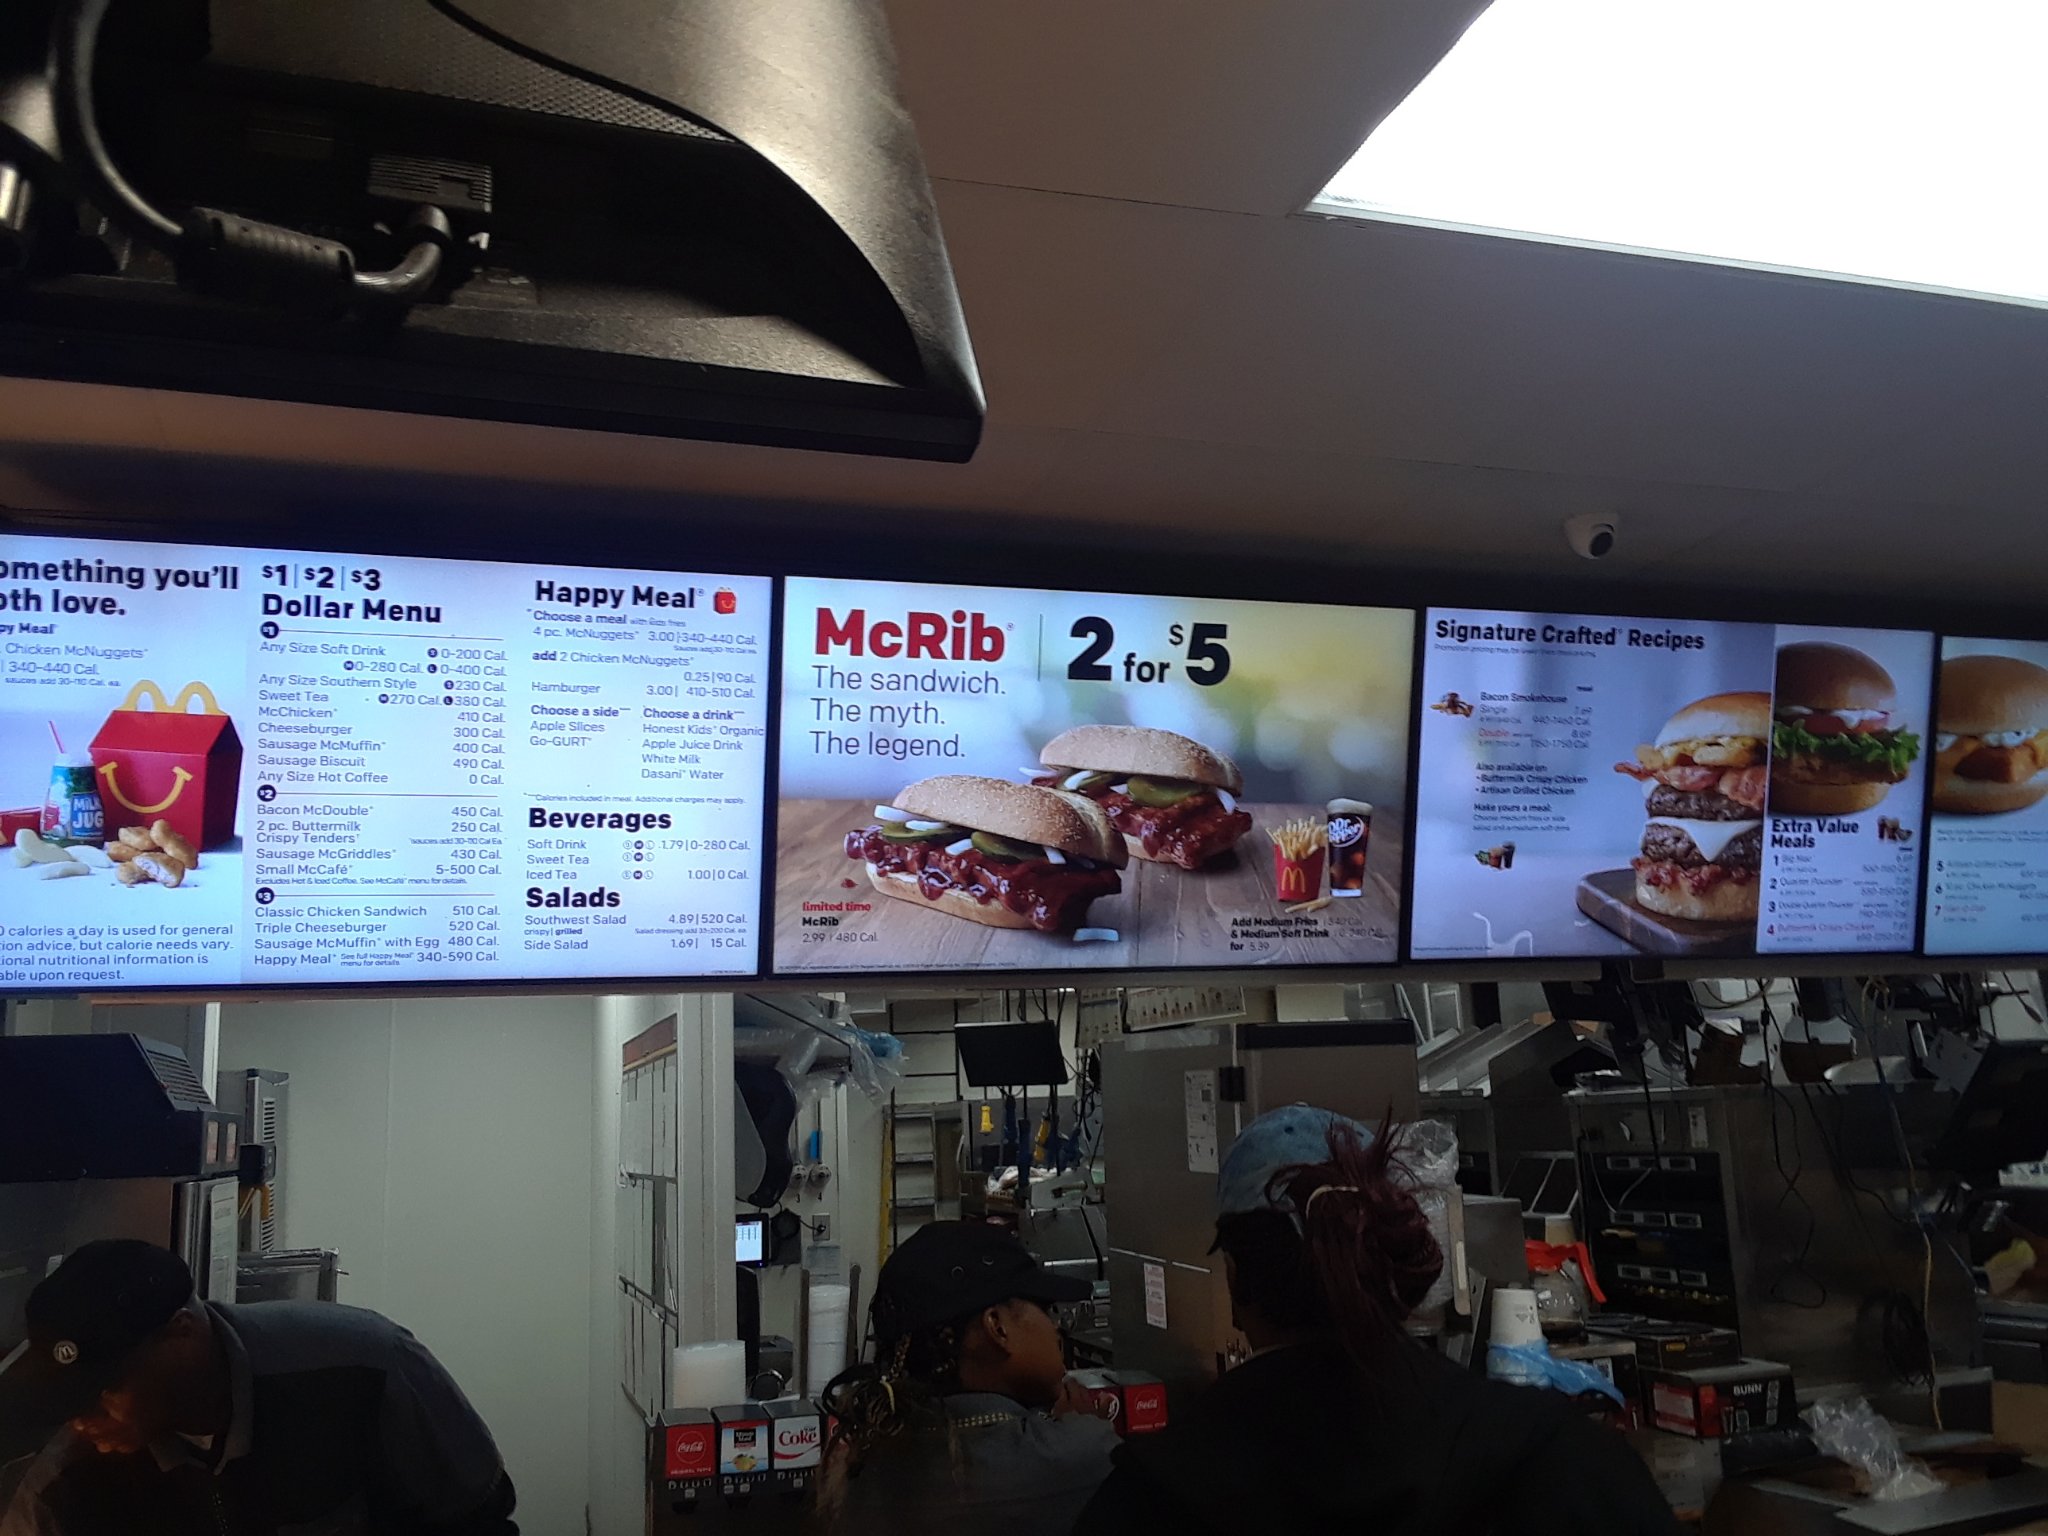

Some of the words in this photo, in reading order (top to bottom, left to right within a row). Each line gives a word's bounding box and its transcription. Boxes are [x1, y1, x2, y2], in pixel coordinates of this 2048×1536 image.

[0, 559, 145, 589] omething
[154, 565, 238, 590] you'll
[262, 565, 287, 586] $1
[305, 567, 334, 588] $2
[352, 569, 381, 591] $3
[536, 580, 625, 609] Happy
[632, 586, 695, 608] Meal
[0, 588, 42, 611] oth
[52, 589, 125, 615] love.
[263, 594, 354, 619] Dollar
[363, 599, 441, 622] Menu
[815, 608, 1006, 662] McRib
[1436, 620, 1536, 644] Signature
[1542, 625, 1617, 646] Crafted
[1629, 630, 1704, 651] Recipes
[6, 643, 61, 655] Chicken
[65, 645, 144, 659] McNuggets
[260, 642, 286, 654] Any
[289, 642, 317, 654] Size
[321, 644, 348, 655] Soft
[352, 645, 385, 656] Drink
[1068, 616, 1114, 681] 2
[1124, 653, 1169, 683] for
[1168, 621, 1231, 686] $5
[9, 661, 71, 673] 340-440
[74, 663, 100, 675] Cal.
[259, 674, 285, 686] Any
[288, 675, 317, 686] Size
[320, 676, 381, 688] Southern
[384, 679, 417, 690] Style
[812, 665, 862, 690] The
[870, 668, 1006, 694] sandwich.
[532, 682, 601, 694] Hamburger
[259, 690, 300, 701] Sweet
[305, 691, 329, 702] Tea
[1480, 691, 1508, 702] Bacon
[1511, 693, 1567, 704] Smokehouse
[811, 699, 861, 722] The
[870, 701, 945, 727] myth.
[258, 723, 352, 735] Cheeseburger
[531, 721, 565, 732] Apple
[569, 722, 605, 732] Slices
[643, 724, 684, 734] Honest
[688, 725, 712, 735] Kids
[720, 725, 763, 737] Organic
[643, 740, 676, 751] Apple
[680, 740, 710, 749] Juice
[714, 740, 743, 750] Drink
[810, 731, 860, 754] The
[868, 732, 965, 760] legend.
[258, 755, 317, 767] Sausage
[320, 756, 365, 767] Biscuit
[642, 755, 676, 764] White
[679, 755, 701, 764] Milk
[258, 771, 283, 783] Any
[287, 771, 315, 782] Size
[318, 772, 341, 782] Hot
[345, 773, 388, 783] Coffee
[642, 770, 682, 779] Dasani
[690, 770, 723, 779] Water
[1481, 775, 1524, 783] Buttermilk
[1527, 775, 1551, 784] Crispy
[1554, 776, 1588, 784] Chicken
[1481, 787, 1511, 795] Artisan
[1513, 787, 1539, 795] Grilled
[1542, 787, 1575, 795] Chicken
[257, 805, 299, 815] Bacon
[303, 806, 369, 815] McDouble
[73, 812, 104, 828] JUG
[529, 808, 671, 832] Beverages
[1772, 819, 1814, 833] Extra
[1817, 820, 1859, 833] Value
[257, 833, 299, 845] Crispy
[303, 833, 355, 843] Tenders
[528, 839, 552, 849] Soft
[556, 840, 586, 849] Drink
[1771, 835, 1815, 848] Meals
[256, 850, 315, 861] Sausage
[318, 850, 391, 860] McGriddles
[527, 855, 565, 864] Sweet
[569, 855, 589, 864] Tea
[436, 865, 475, 875] 5-500
[479, 865, 501, 875] Cal.
[527, 870, 552, 880] Iced
[556, 870, 577, 880] Tea
[526, 887, 620, 908] Salads
[255, 907, 303, 917] Classic
[308, 906, 359, 916] Chicken
[364, 906, 426, 916] Sandwich
[453, 906, 474, 916] 510
[477, 906, 500, 915] Cal.
[803, 902, 843, 912] limited
[846, 902, 871, 912] time
[525, 915, 589, 924] Southwest
[593, 915, 626, 924] Salad
[802, 916, 839, 926] McRib
[1232, 918, 1251, 926] Add
[1254, 918, 1292, 926] Medium
[1295, 918, 1318, 926] Fries
[9, 926, 62, 936] calories
[67, 928, 76, 936] a
[79, 926, 103, 938] day
[108, 926, 118, 935] is
[122, 926, 155, 935] used
[160, 926, 178, 935] for
[182, 925, 233, 937] general
[255, 923, 291, 933] Triple
[296, 922, 386, 933] Cheeseburger
[450, 921, 473, 931] 520
[477, 921, 500, 931] Cal.
[803, 933, 825, 942] 2.99
[837, 933, 857, 942] 480
[860, 933, 878, 942] Cal.
[1231, 930, 1237, 938] &
[1241, 930, 1279, 938] Medium
[1282, 929, 1300, 938] Soft
[1304, 929, 1329, 937] Drink
[0, 940, 22, 951] ion
[27, 940, 75, 951] advice,
[80, 940, 102, 950] but
[106, 939, 152, 950] calorie
[156, 940, 197, 949] needs
[202, 941, 235, 951] vary.
[255, 939, 312, 951] Sausage
[317, 938, 376, 948] McMuffin
[385, 937, 411, 947] with
[416, 937, 439, 948] Egg
[524, 940, 550, 949] Side
[554, 940, 588, 949] Salad
[1231, 942, 1244, 951] for
[0, 955, 34, 965] ional
[39, 955, 109, 965] nutritional
[114, 954, 193, 964] information
[199, 954, 208, 963] is
[255, 955, 296, 966] Happy
[301, 954, 330, 964] Meal
[417, 952, 473, 962] 340-590
[476, 952, 499, 961] Cal.
[0, 970, 25, 980] able
[30, 972, 63, 982] upon
[68, 970, 124, 981] request.
[1733, 1384, 1762, 1396] BUNN
[779, 1429, 817, 1447] Coke
